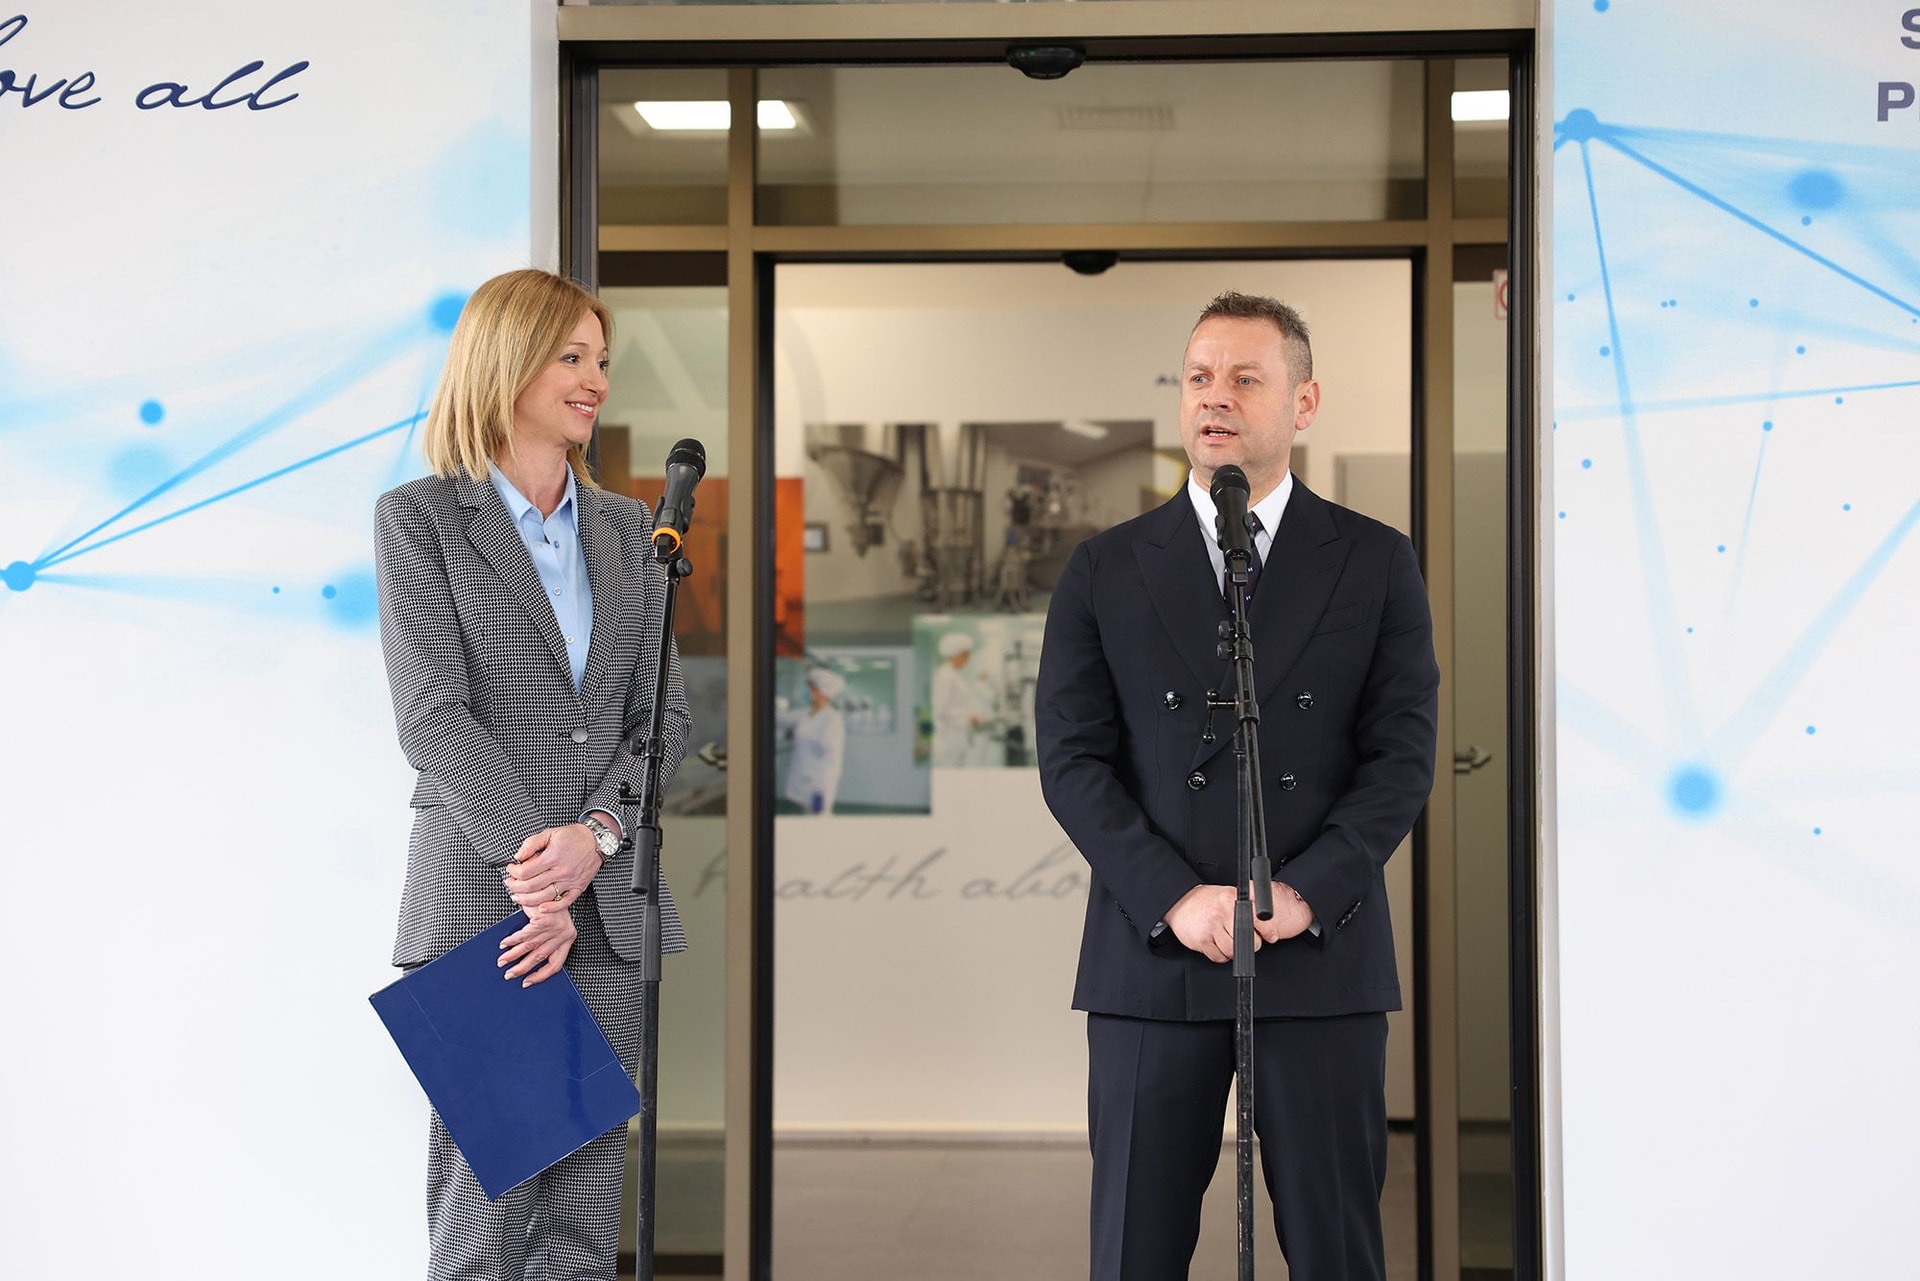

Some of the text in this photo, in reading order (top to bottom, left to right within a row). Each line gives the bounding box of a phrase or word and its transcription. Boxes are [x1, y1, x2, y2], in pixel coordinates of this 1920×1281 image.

[135, 60, 310, 110] all
[1877, 81, 1920, 122] P
[692, 840, 1090, 902] halth abo
